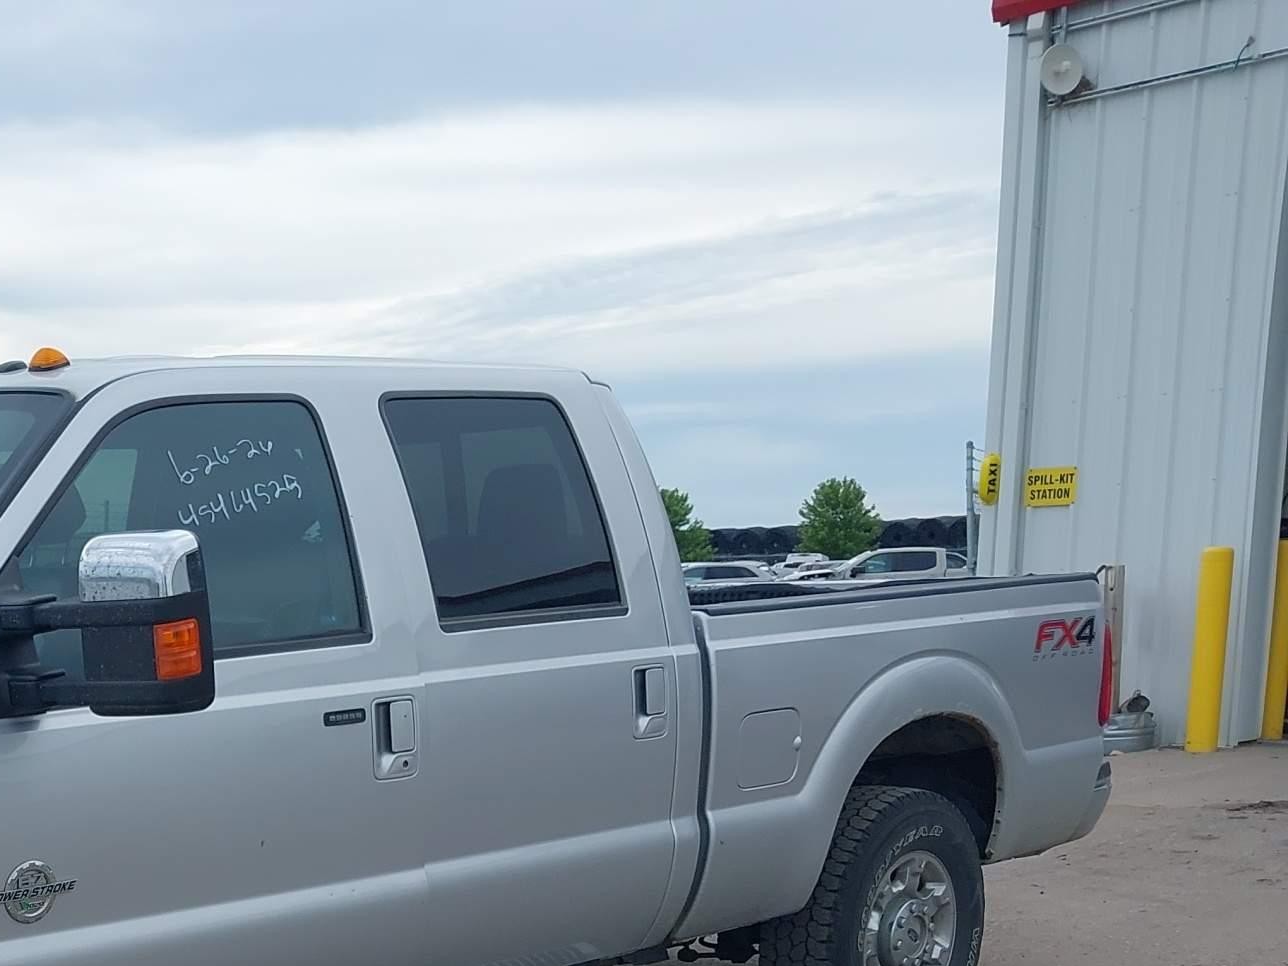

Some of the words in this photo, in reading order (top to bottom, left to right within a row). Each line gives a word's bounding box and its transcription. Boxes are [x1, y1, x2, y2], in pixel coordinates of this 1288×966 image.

[987, 463, 998, 496] TAXI
[1027, 472, 1076, 487] SPILL-KIT
[1029, 487, 1071, 501] STATION
[1033, 614, 1097, 653] FX4
[30, 879, 79, 898] STROKE
